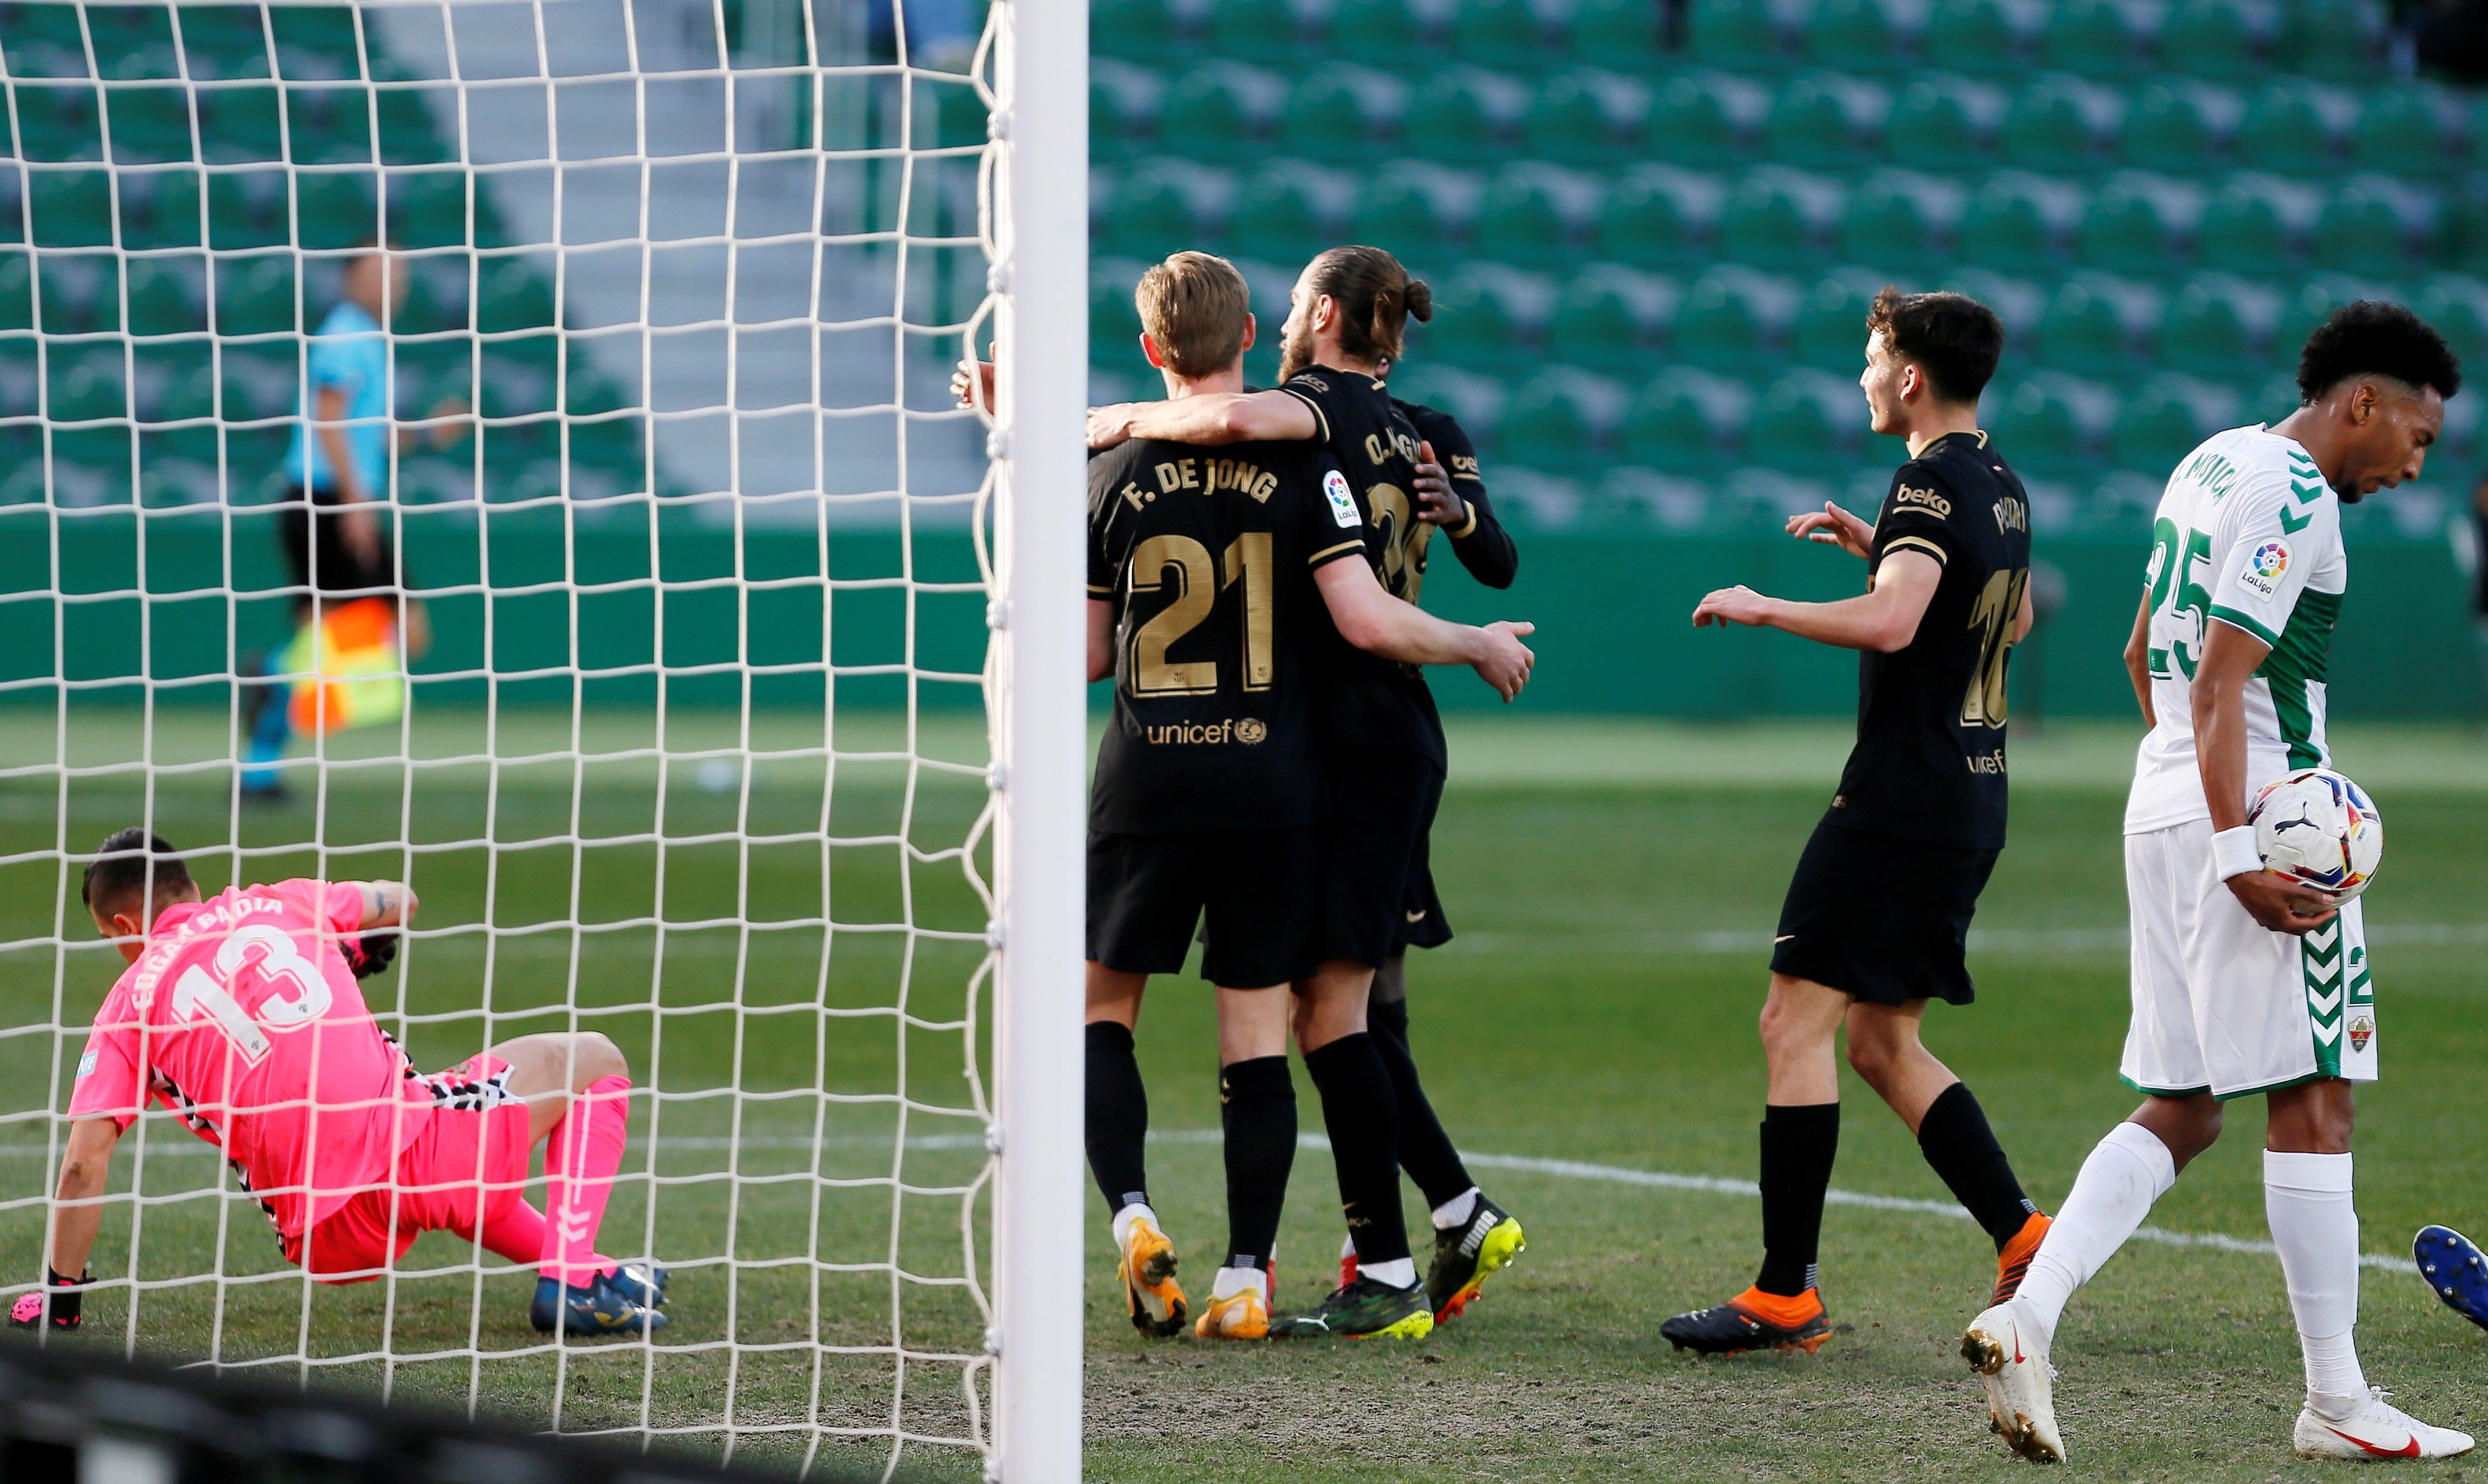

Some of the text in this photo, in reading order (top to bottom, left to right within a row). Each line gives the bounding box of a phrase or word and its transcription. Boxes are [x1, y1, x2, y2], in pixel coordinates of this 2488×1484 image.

[1121, 458, 1278, 511] F. DE JONG
[1897, 484, 1952, 515] beko
[2148, 517, 2212, 683] 25
[2242, 572, 2273, 594] LaLiga
[1128, 532, 1273, 698] 21
[1147, 718, 1233, 744] unicef
[196, 897, 282, 929] BADIA
[170, 924, 332, 1069] 13
[1459, 1210, 1498, 1260] PUMA
